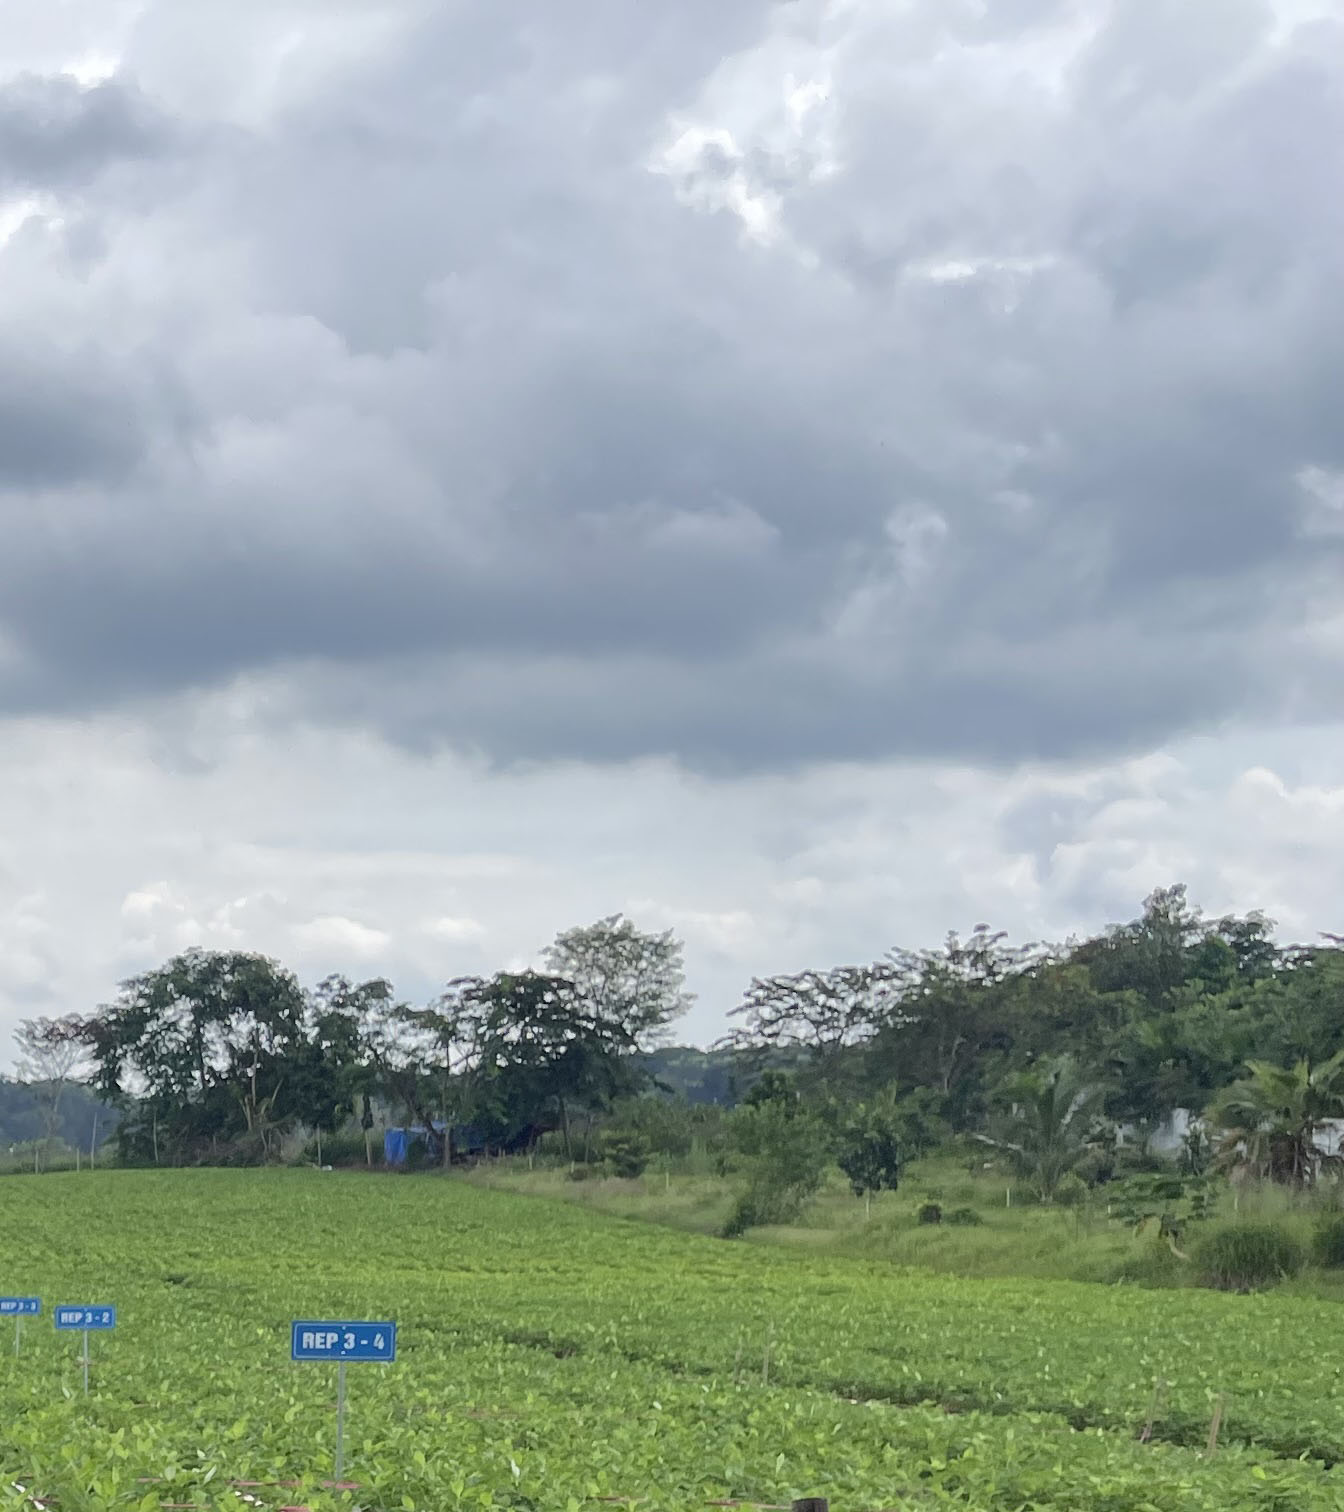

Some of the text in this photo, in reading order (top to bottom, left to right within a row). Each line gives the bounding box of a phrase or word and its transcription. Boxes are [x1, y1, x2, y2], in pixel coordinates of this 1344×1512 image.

[61, 1312, 82, 1323] REP
[86, 1312, 92, 1323] 3
[102, 1312, 110, 1323] 2
[303, 1332, 338, 1349] REP
[344, 1333, 355, 1349] 3
[374, 1333, 384, 1350] 4
